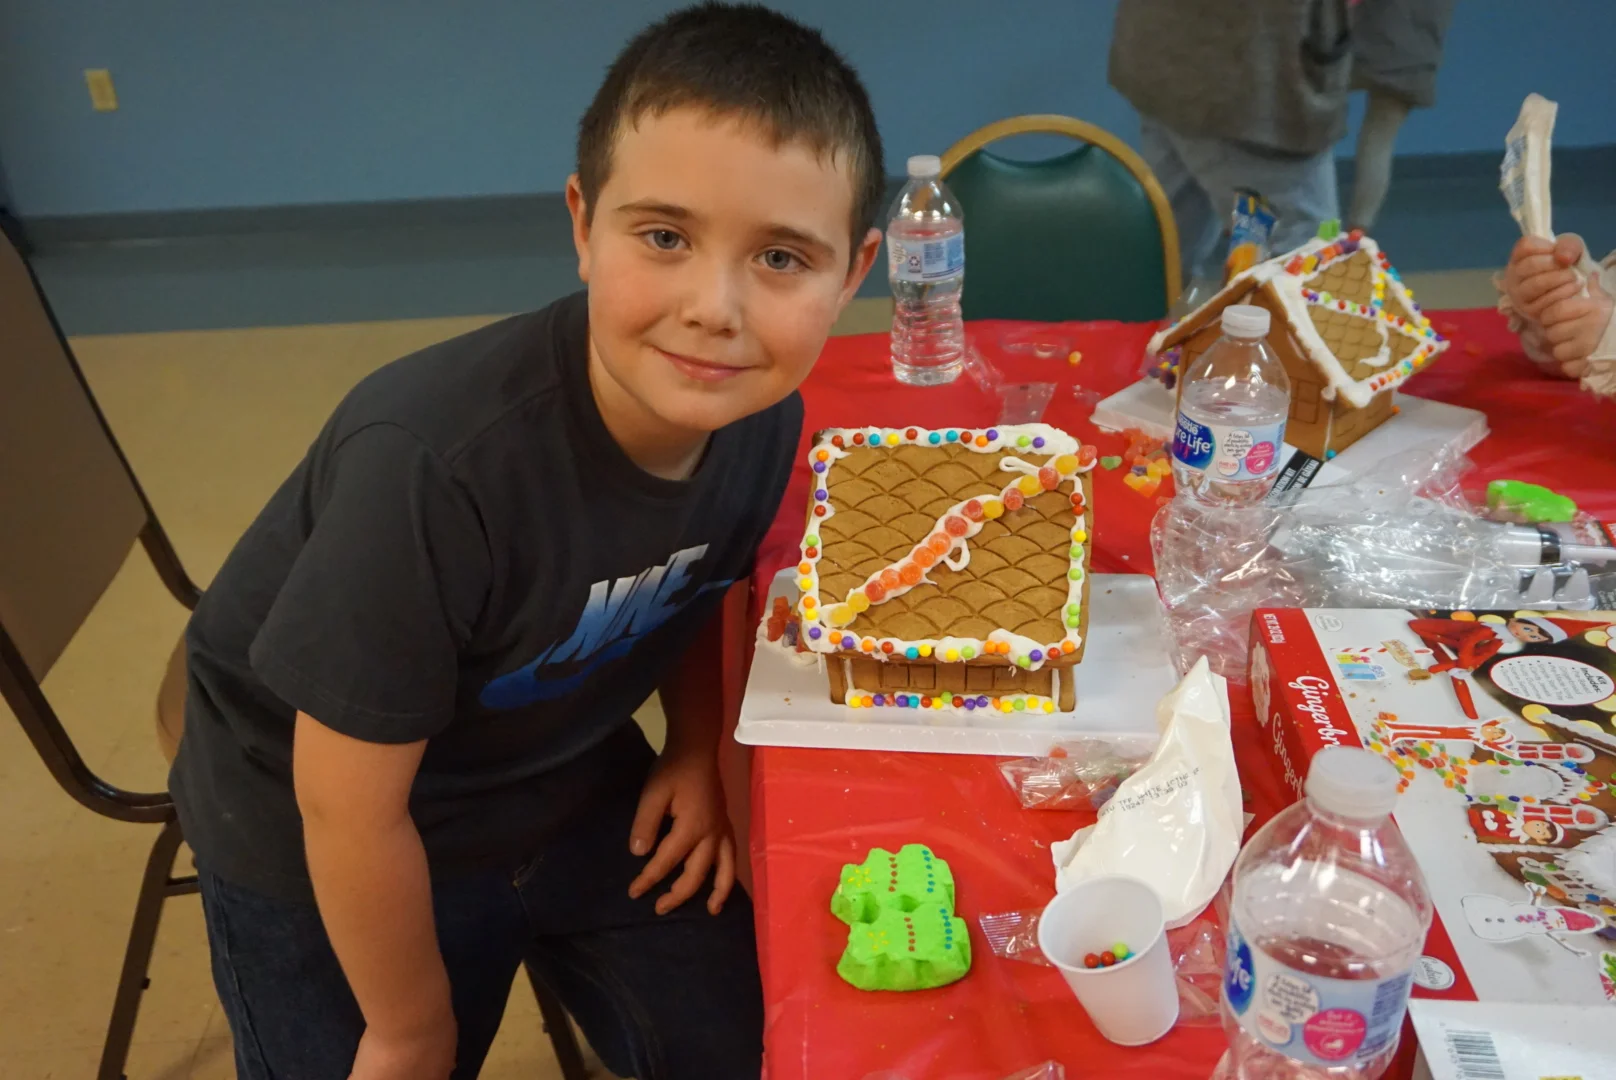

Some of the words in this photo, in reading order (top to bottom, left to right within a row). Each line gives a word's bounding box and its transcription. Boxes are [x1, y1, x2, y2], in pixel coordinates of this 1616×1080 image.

[1187, 433, 1212, 456] Life
[544, 543, 710, 665] NIKE
[1580, 667, 1602, 693] Includes:
[1596, 675, 1607, 685] Kit
[1288, 676, 1348, 749] Gingerbr
